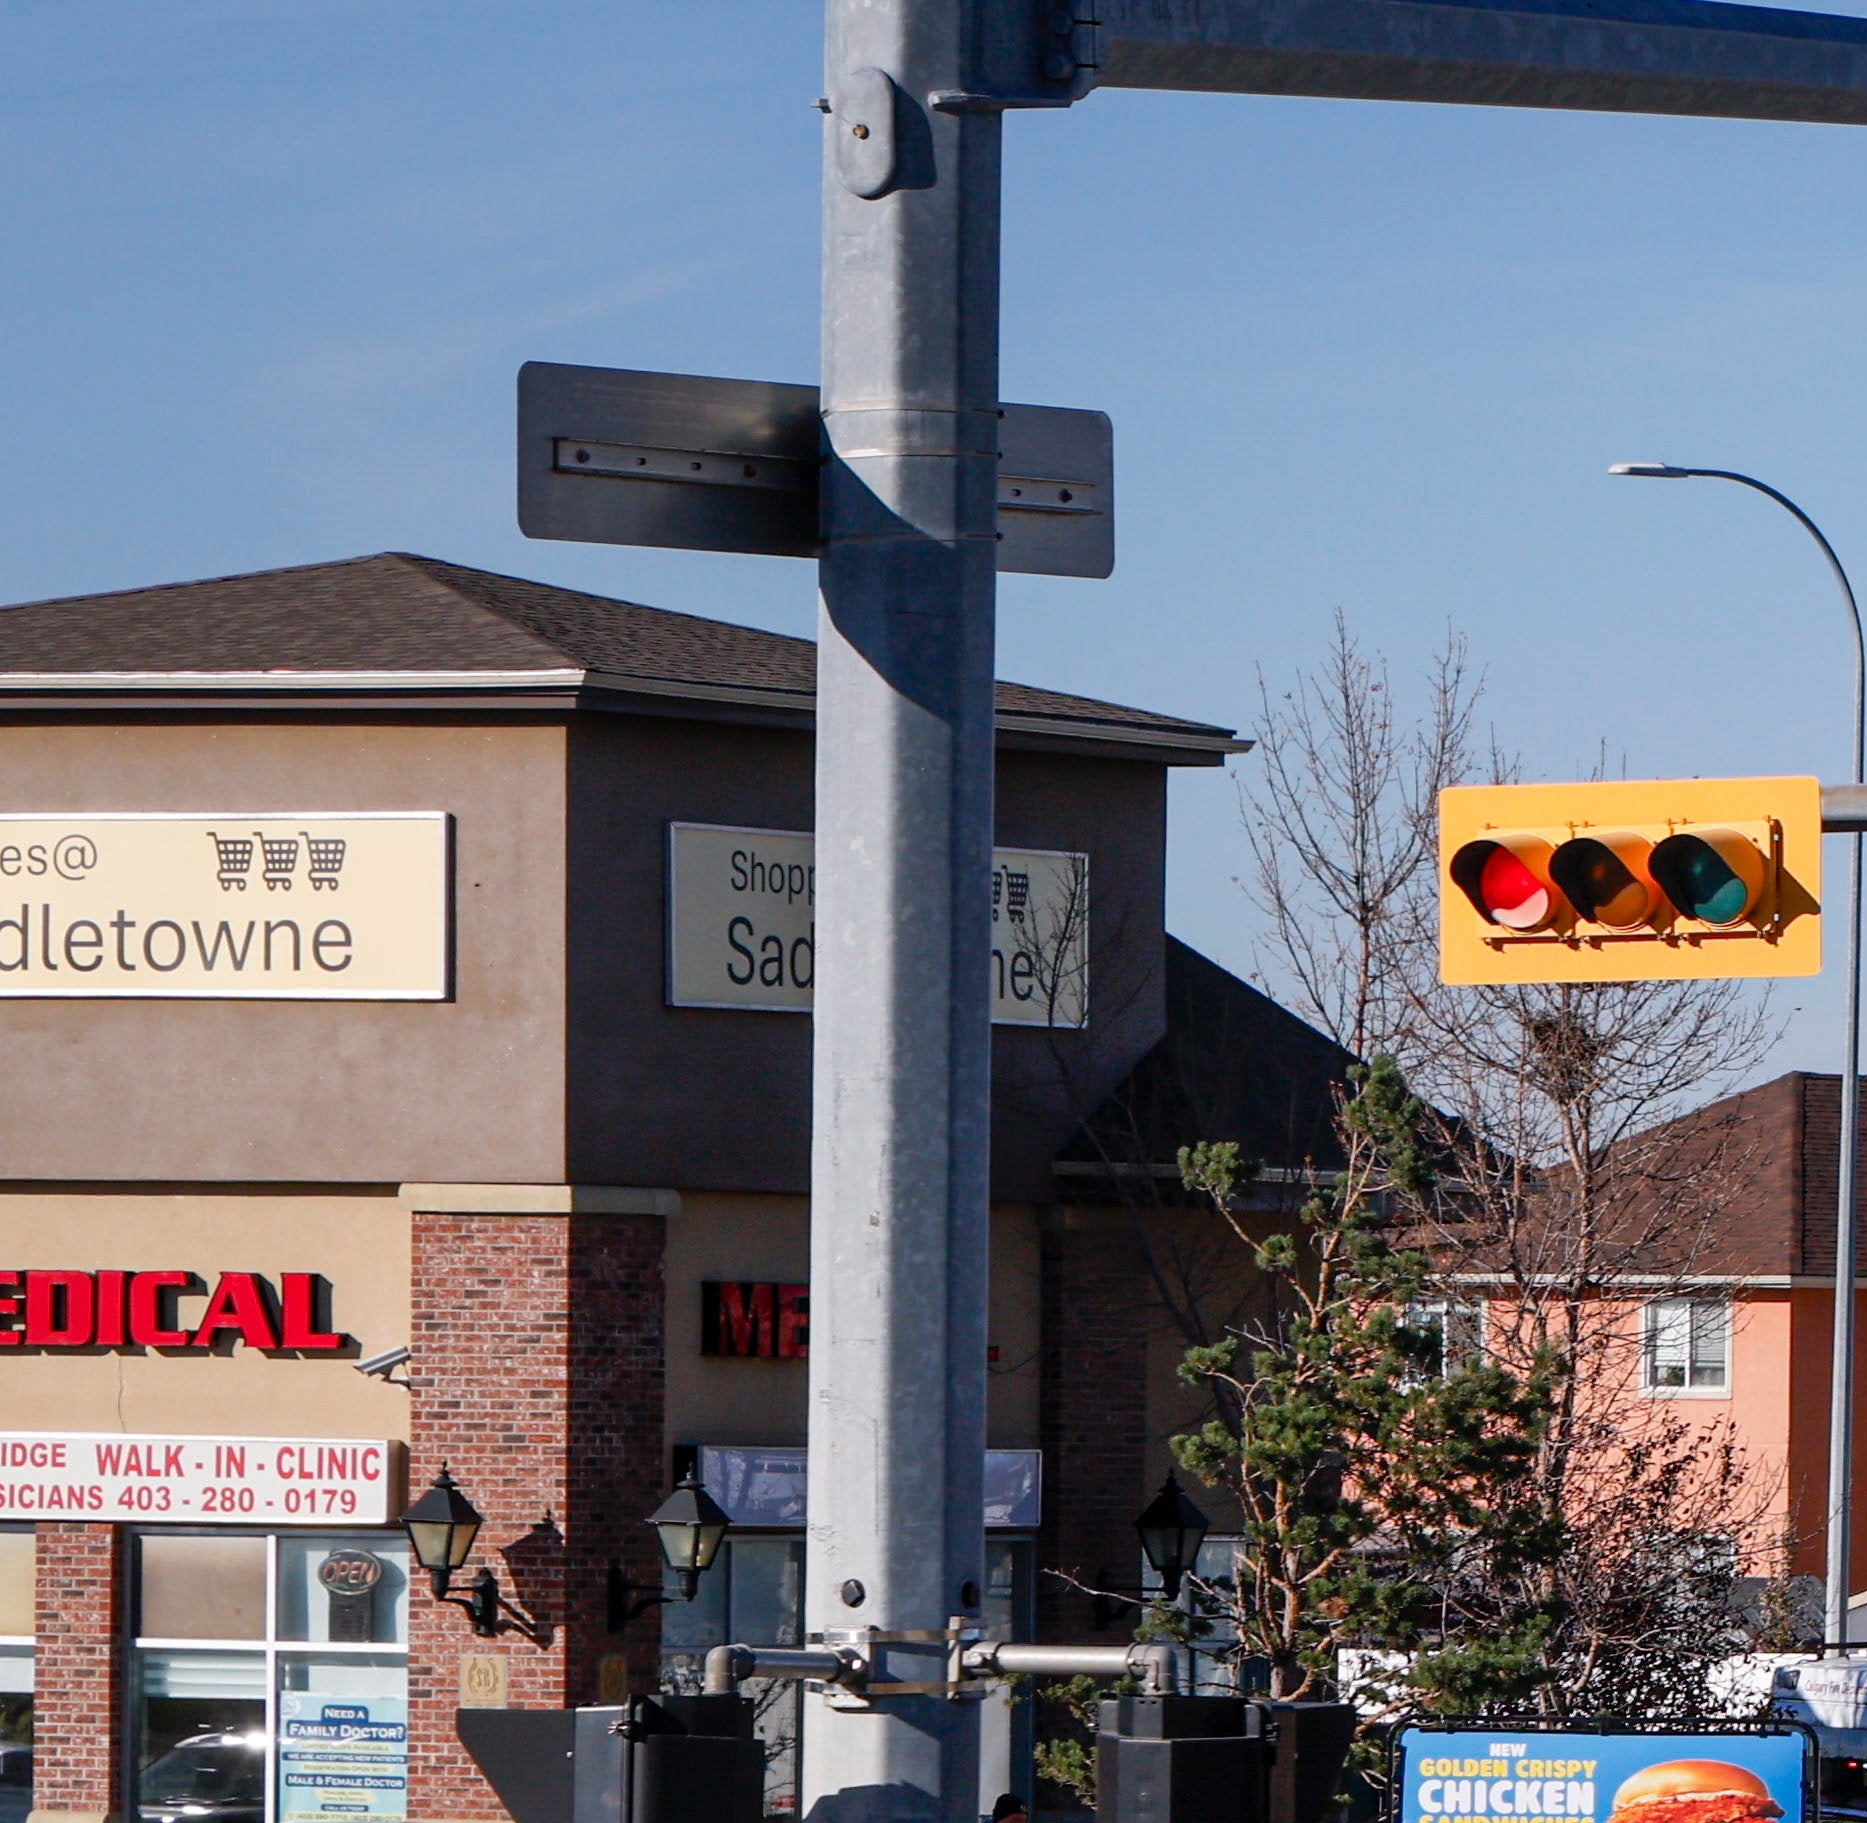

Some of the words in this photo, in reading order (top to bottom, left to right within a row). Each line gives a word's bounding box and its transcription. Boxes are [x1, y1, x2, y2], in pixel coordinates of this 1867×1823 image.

[96, 1444, 185, 1477] WALK
[215, 1446, 246, 1478] IN
[276, 1447, 380, 1480] CLINIC
[118, 1486, 172, 1511] 403
[201, 1487, 255, 1513] 280
[284, 1489, 357, 1514] 0179
[322, 1559, 375, 1584] OPEN
[325, 1708, 355, 1719] NEED
[289, 1723, 339, 1737] FAMILY
[340, 1725, 405, 1739] DOCTOR?
[1489, 1743, 1526, 1757] NEW
[1419, 1759, 1509, 1777] GOLDEN
[1515, 1759, 1597, 1778] CRISPY
[288, 1776, 314, 1785] MALE
[325, 1777, 362, 1786] FEMALE
[364, 1778, 403, 1787] DOCTOR
[1418, 1779, 1595, 1815] CHICKEN
